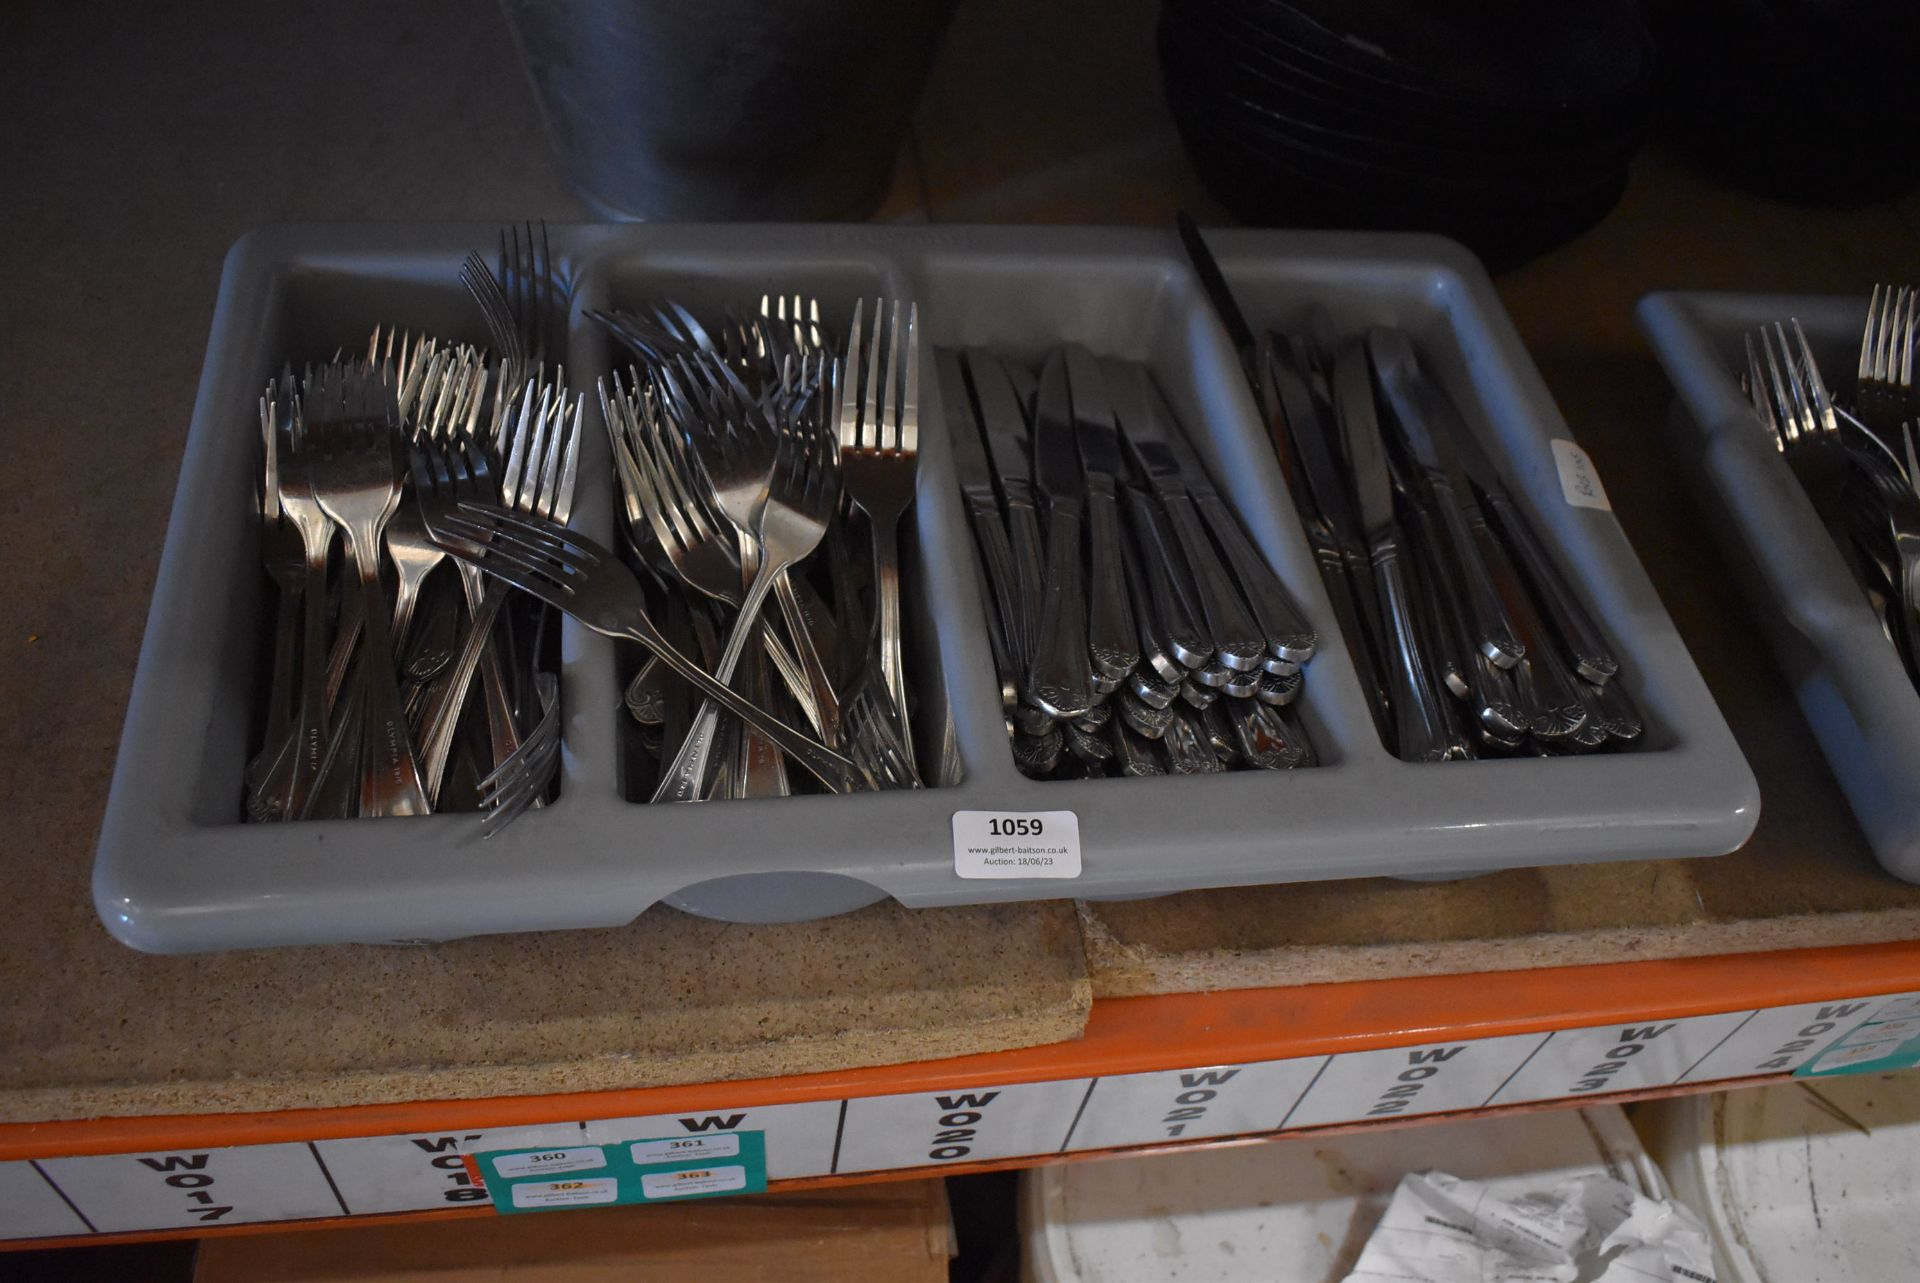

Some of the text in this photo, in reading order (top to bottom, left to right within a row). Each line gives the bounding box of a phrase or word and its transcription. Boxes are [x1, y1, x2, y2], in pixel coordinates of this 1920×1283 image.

[989, 818, 1043, 836] 1059
[968, 846, 1068, 856] www.gilbert-baitson.co.uk
[984, 857, 1053, 867] Auction: 18/06/23
[670, 1140, 705, 1149] 361
[529, 1152, 566, 1163] 360
[550, 1182, 583, 1190] 362
